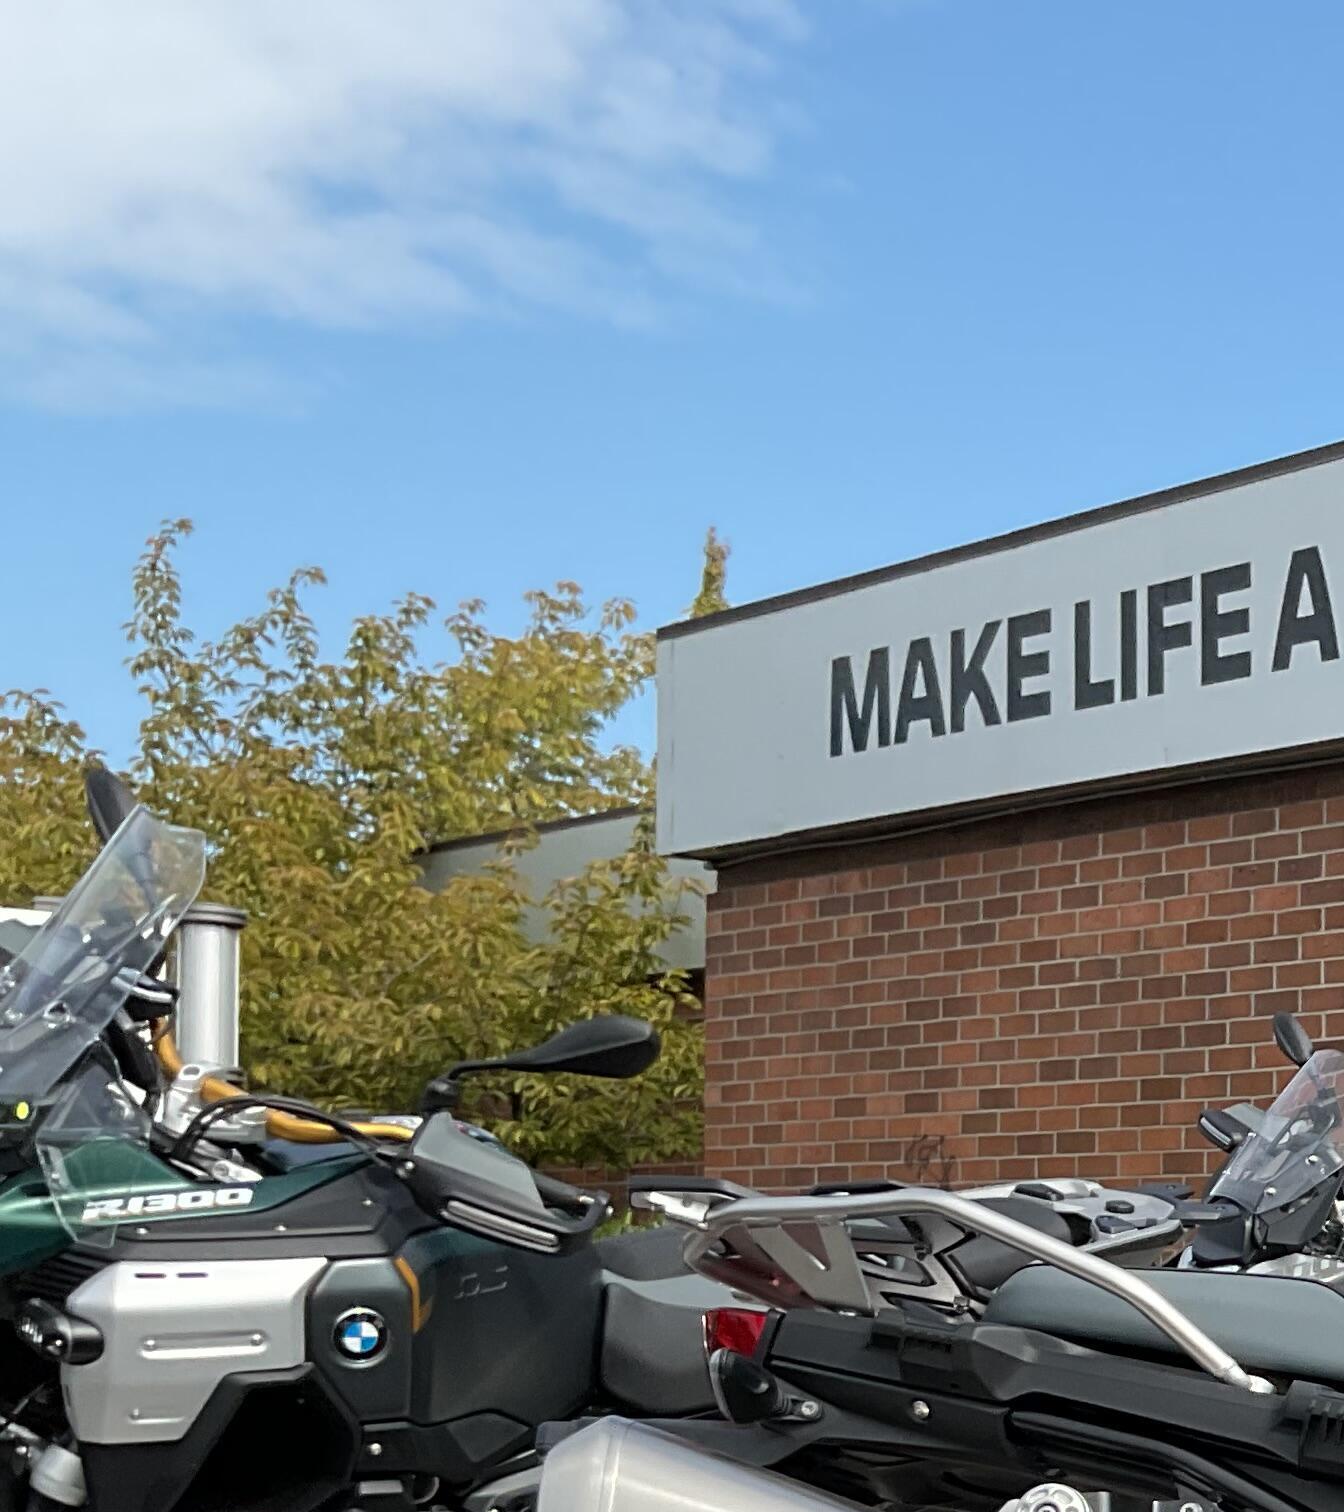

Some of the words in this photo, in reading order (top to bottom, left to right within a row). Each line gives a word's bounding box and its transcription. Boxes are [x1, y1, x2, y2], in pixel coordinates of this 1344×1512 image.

[830, 609, 1052, 757] MAKE
[1075, 562, 1252, 710] LIFE
[1272, 546, 1340, 673] A
[82, 1188, 253, 1224] R1300
